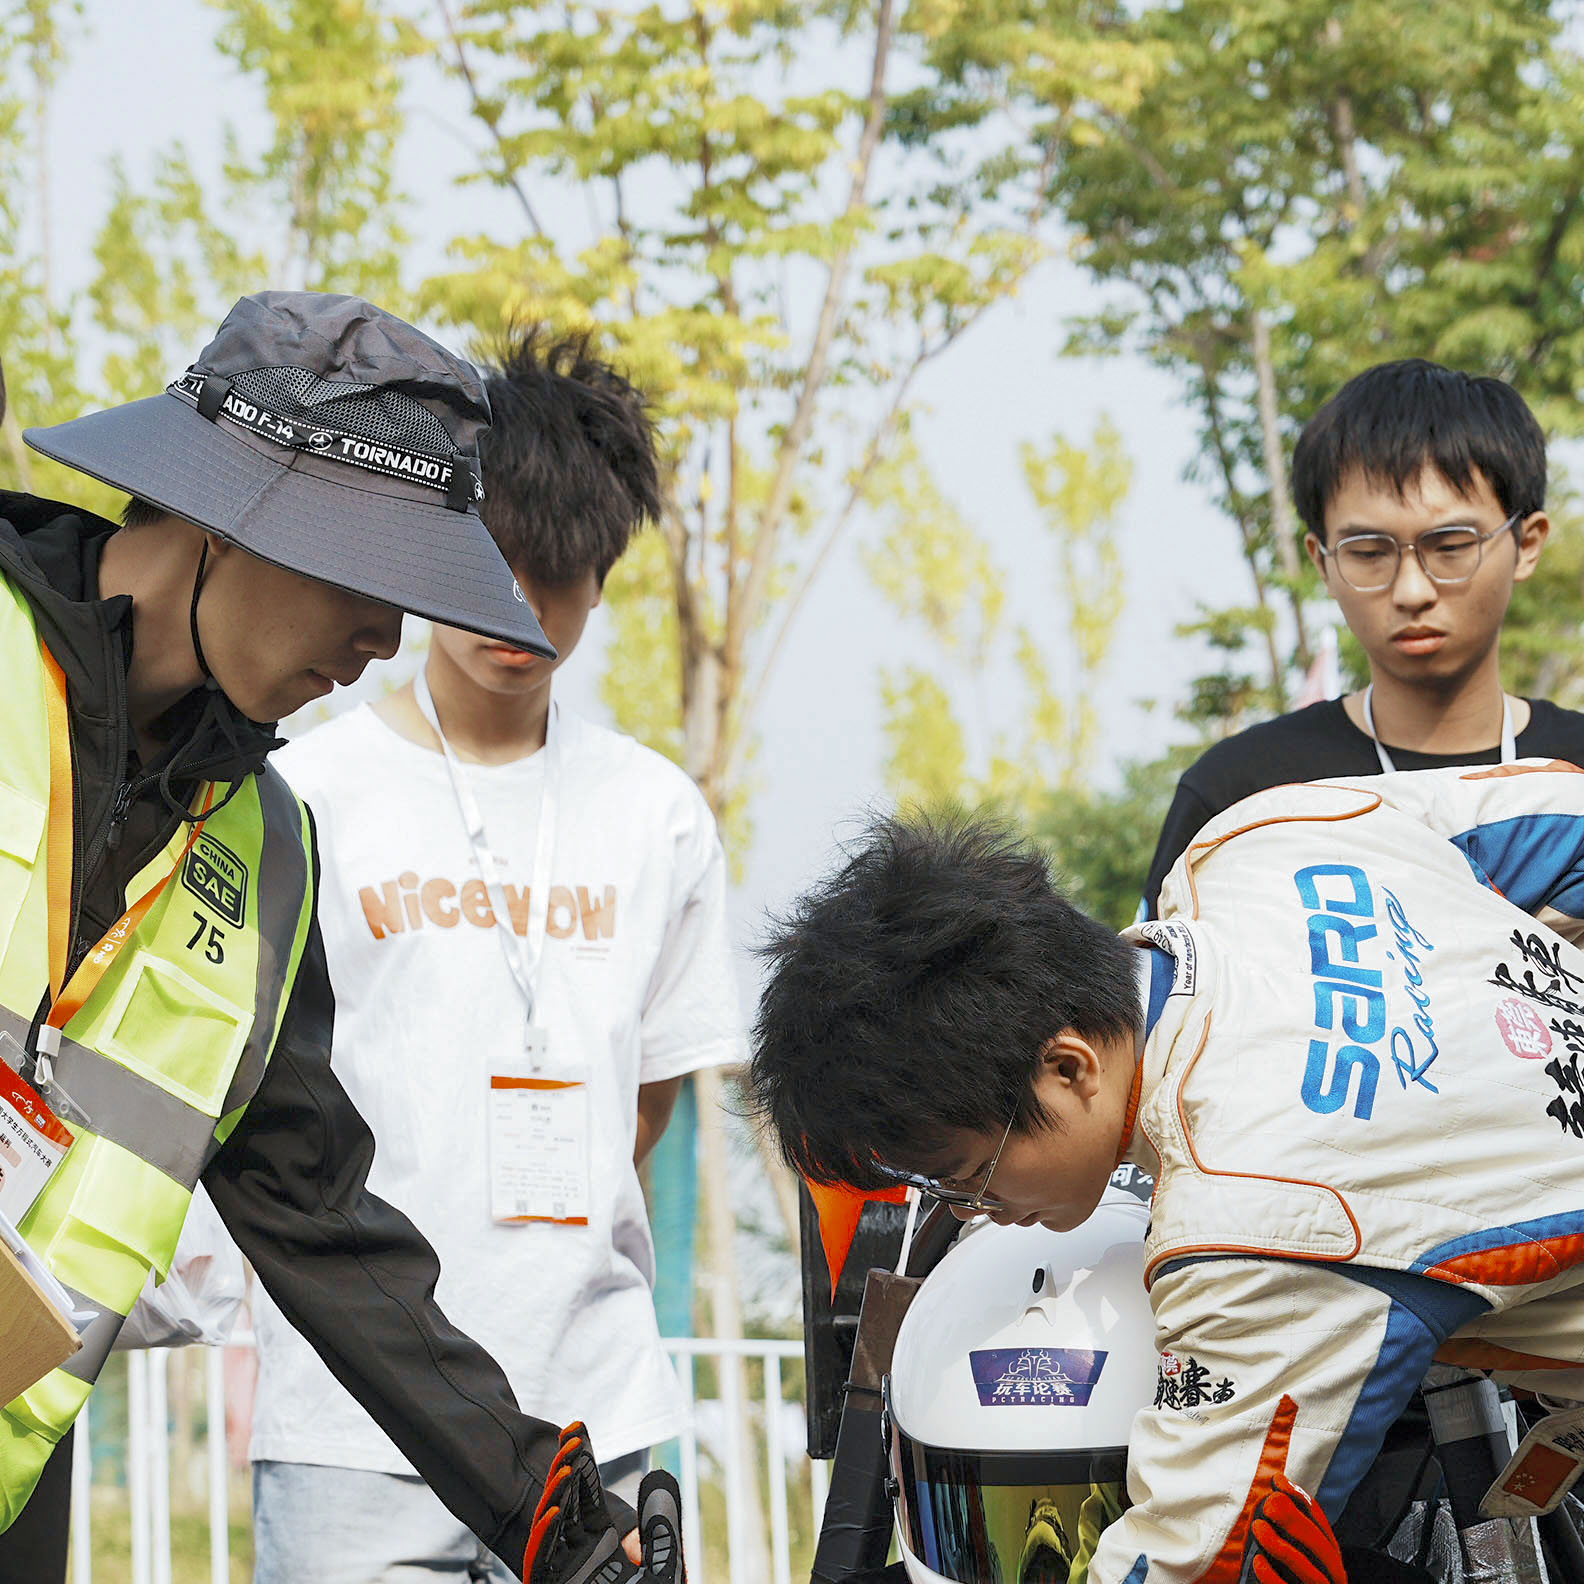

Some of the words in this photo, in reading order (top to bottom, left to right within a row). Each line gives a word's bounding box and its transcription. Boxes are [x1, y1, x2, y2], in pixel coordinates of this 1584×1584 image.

[257, 409, 295, 440] F-14
[340, 437, 433, 477] TORNADO
[433, 465, 453, 484] F
[199, 843, 236, 881] CHINA
[193, 862, 236, 912] SAE
[186, 911, 226, 965] 75
[1378, 881, 1440, 1094] Racing
[992, 1382, 1075, 1397] 玩车论赛
